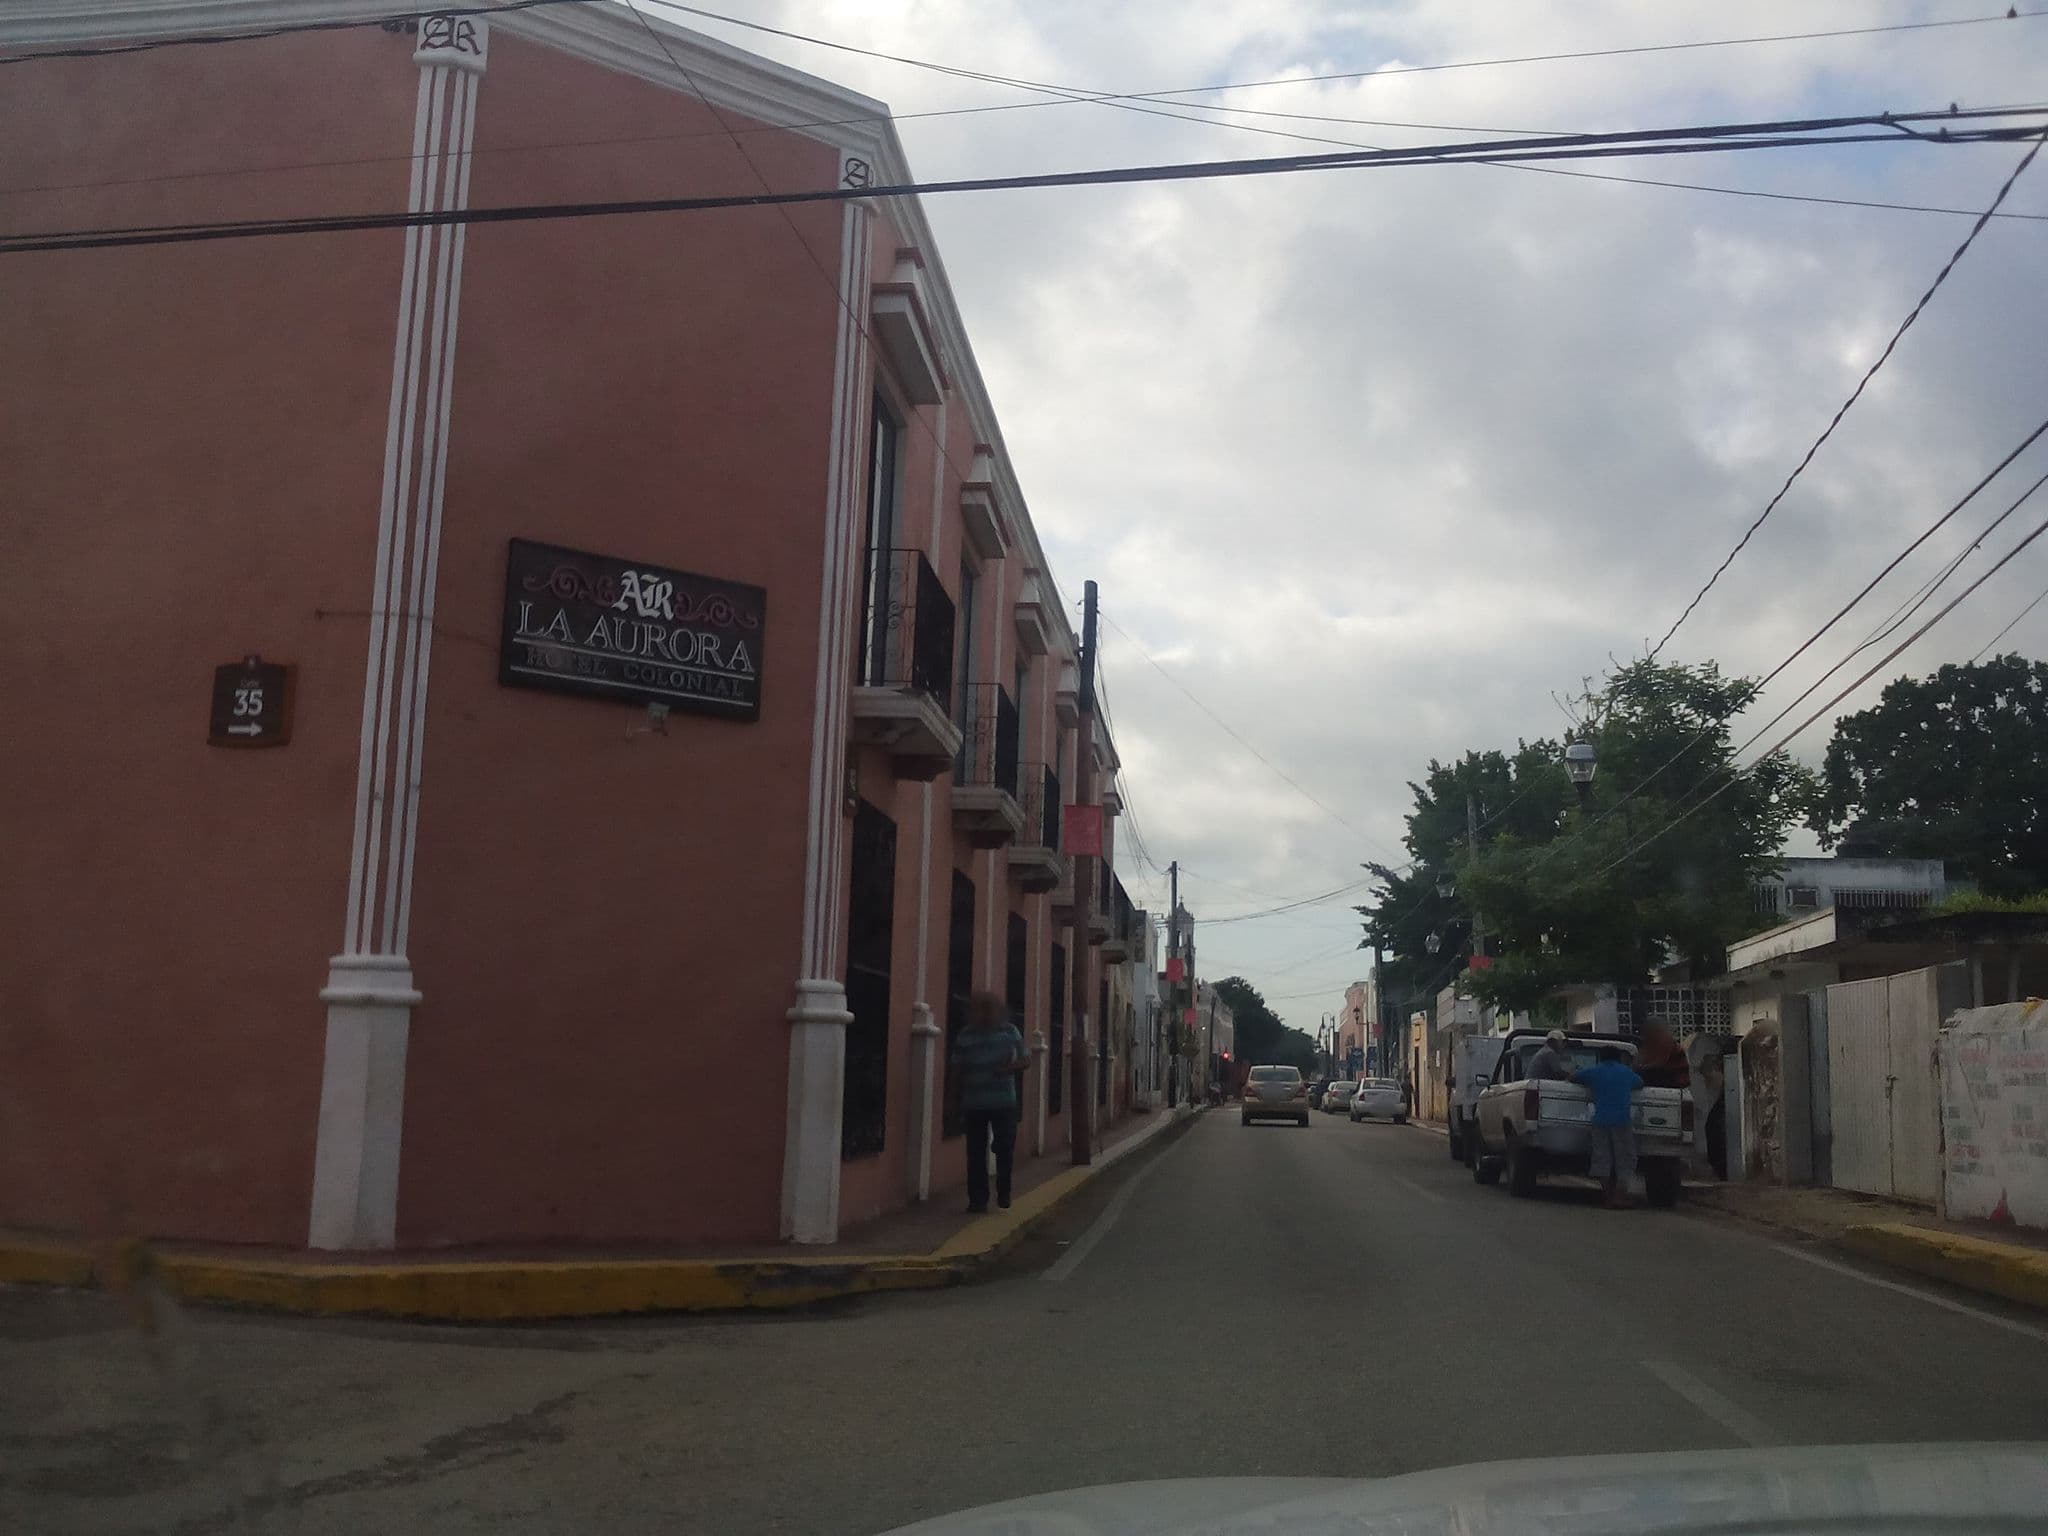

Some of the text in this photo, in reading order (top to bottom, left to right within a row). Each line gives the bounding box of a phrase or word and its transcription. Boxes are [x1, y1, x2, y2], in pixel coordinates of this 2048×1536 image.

[515, 600, 754, 672] LA AURORA
[624, 663, 744, 697] COLONIAL
[233, 689, 263, 716] 35
